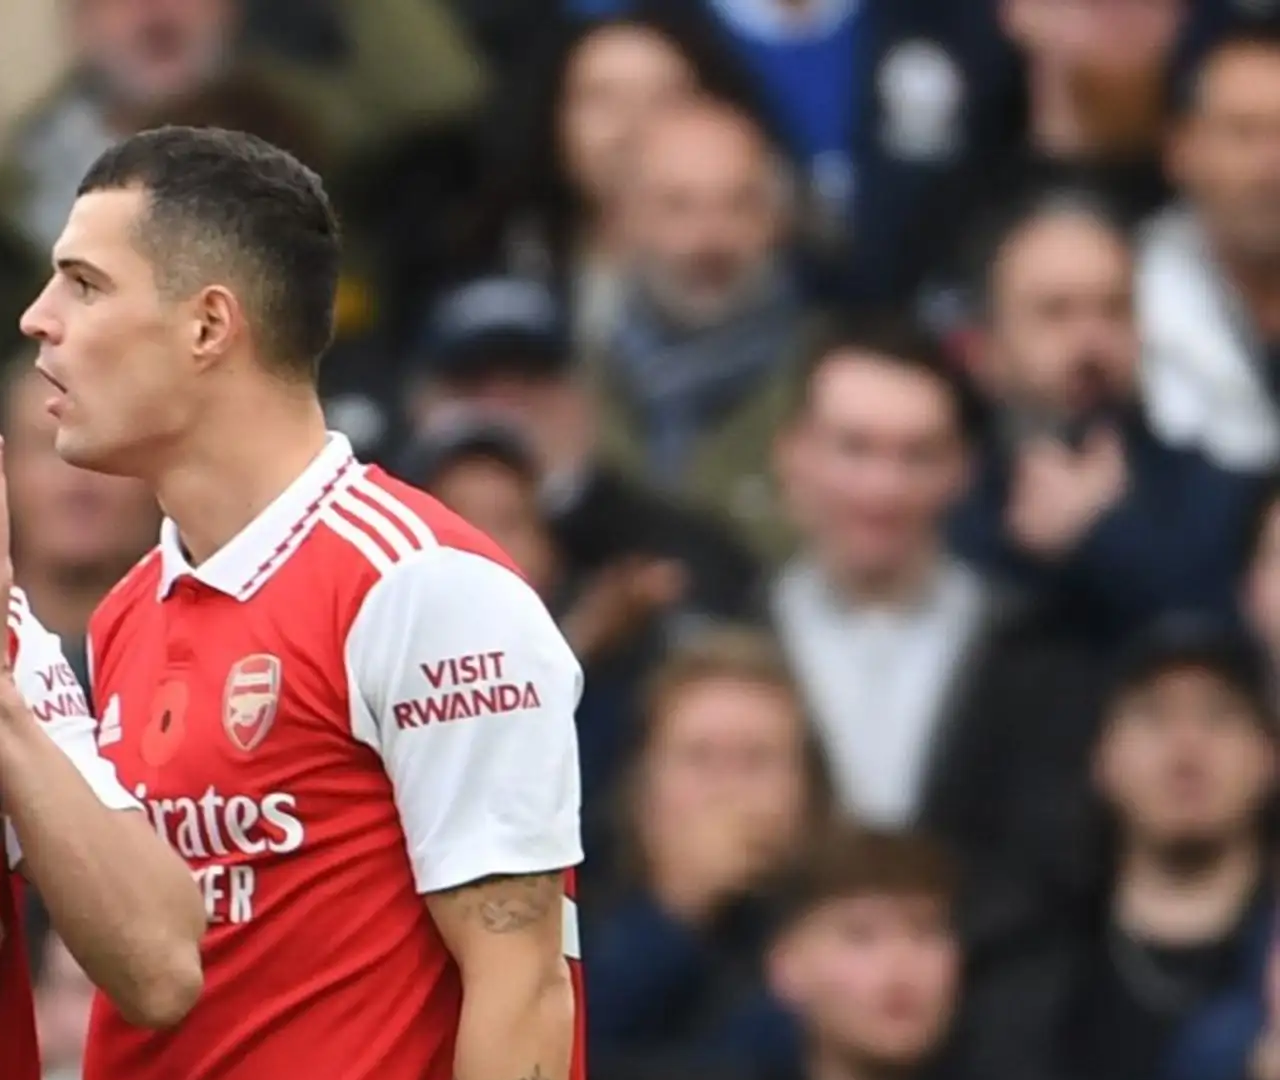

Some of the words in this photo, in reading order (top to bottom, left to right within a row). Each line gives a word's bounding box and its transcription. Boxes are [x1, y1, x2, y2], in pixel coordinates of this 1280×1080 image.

[420, 651, 505, 689] VISIT
[393, 681, 542, 731] RWANDA
[135, 782, 304, 857] rates
